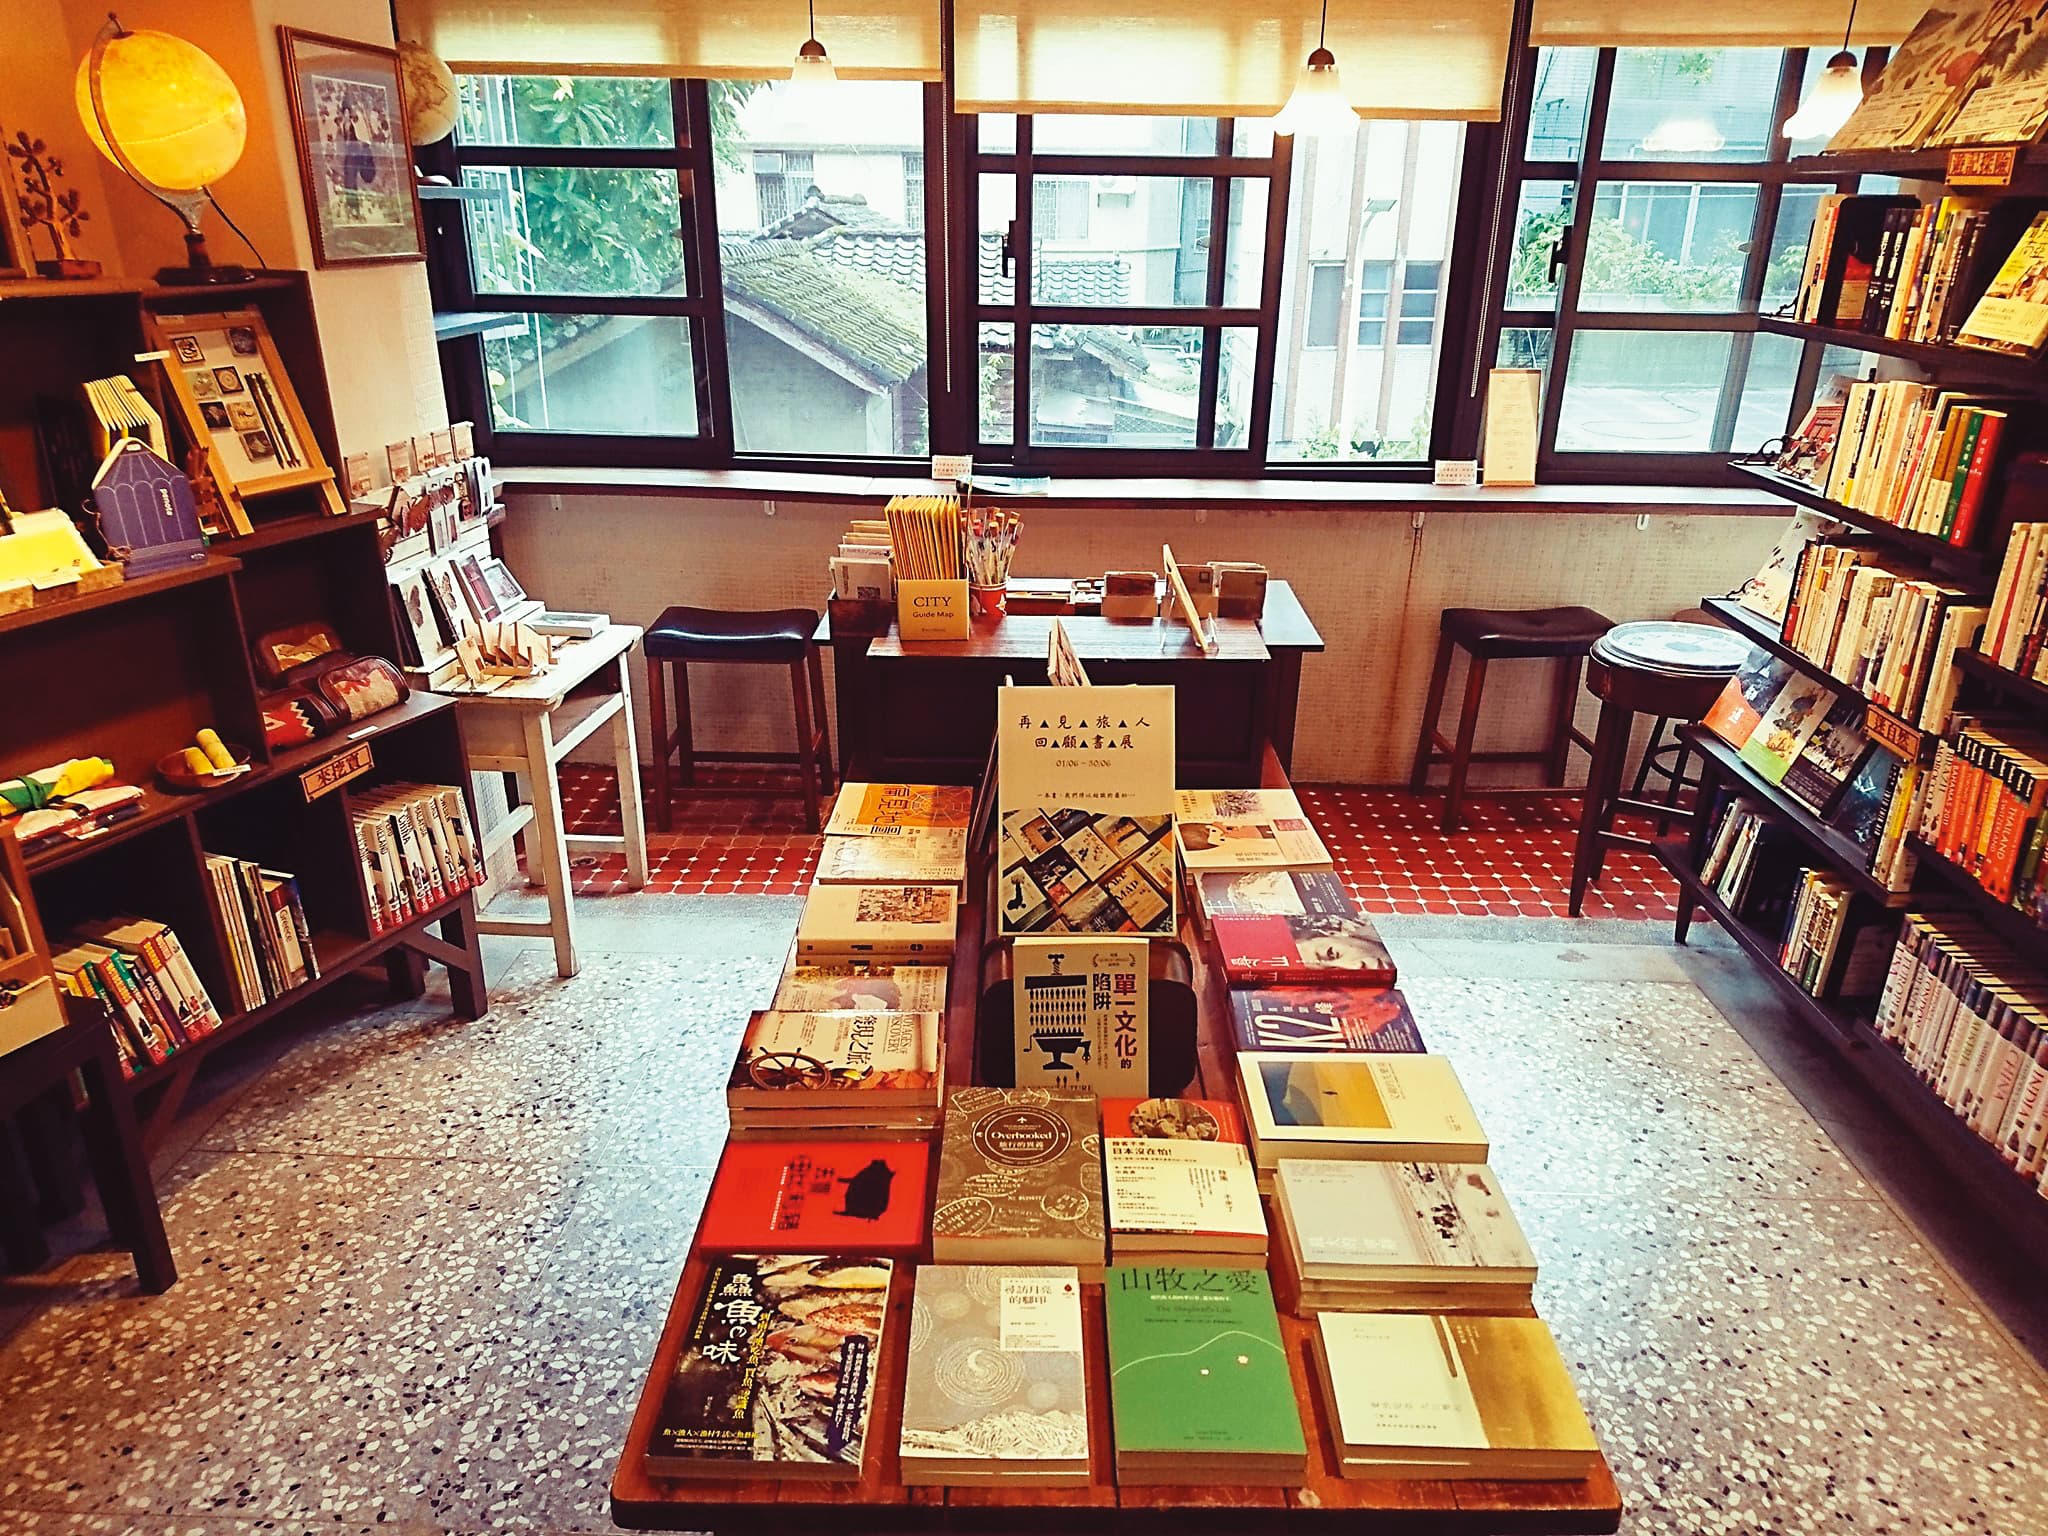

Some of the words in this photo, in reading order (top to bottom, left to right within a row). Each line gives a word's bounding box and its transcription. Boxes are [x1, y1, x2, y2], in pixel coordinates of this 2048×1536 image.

[913, 596, 952, 608] CITY
[1924, 745, 1947, 802] MOROCCO
[1943, 765, 1962, 807] BAHAMAS
[397, 815, 411, 845] CHINA
[1988, 799, 2009, 853] SWITZERLAND
[1995, 807, 2017, 861] THAILAND
[2030, 828, 2044, 852] USA
[278, 908, 296, 943] Greece
[144, 975, 163, 1002] PARIS
[1092, 973, 1112, 1011] 陷阱
[1888, 957, 1914, 1009] EUROPE
[1911, 975, 1935, 1028] LONDON
[1113, 973, 1138, 1070] 單一文化的
[1254, 1014, 1348, 1049] K2
[1992, 1048, 2021, 1104] CHINA
[2016, 1068, 2045, 1121] INDIA
[991, 1131, 1052, 1139] Overbooked
[1121, 1267, 1260, 1295] 山牧之愛
